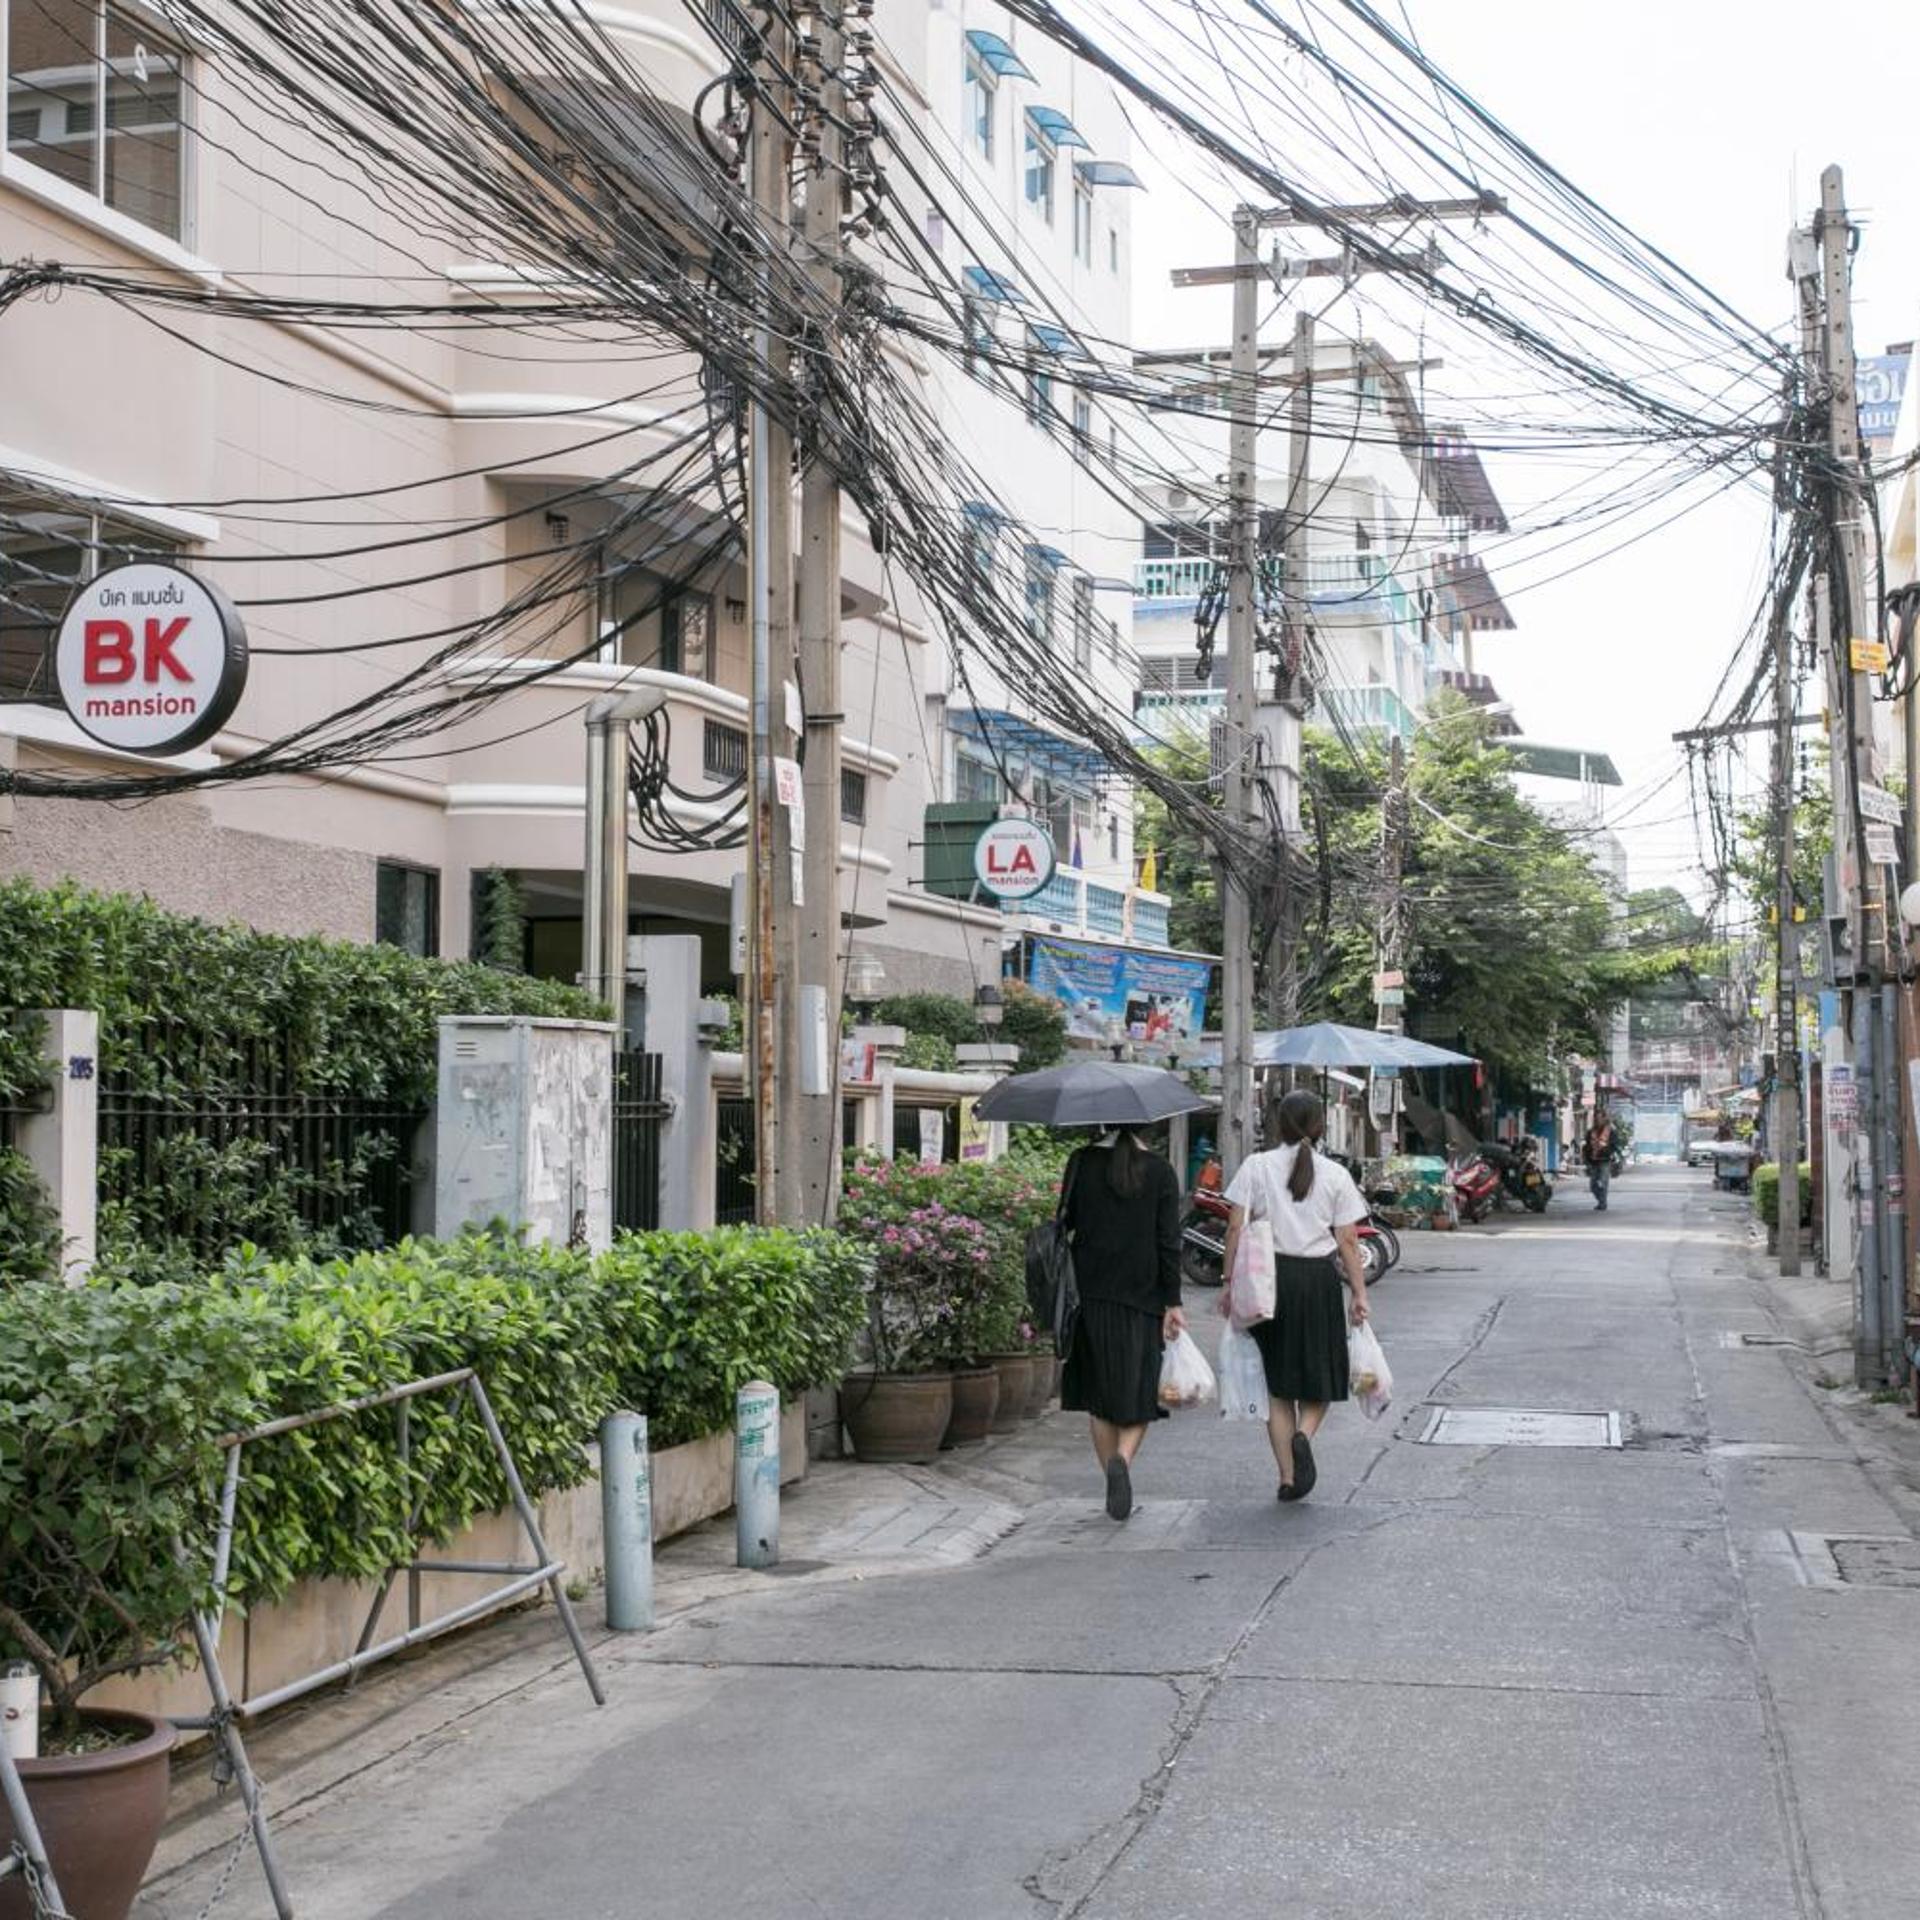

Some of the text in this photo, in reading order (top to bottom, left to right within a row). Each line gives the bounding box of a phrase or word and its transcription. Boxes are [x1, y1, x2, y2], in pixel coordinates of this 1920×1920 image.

[131, 581, 184, 605] แมนชั่น
[84, 617, 195, 684] BK
[87, 693, 196, 717] mansion
[987, 844, 1036, 873] LA
[986, 874, 1039, 886] mansion
